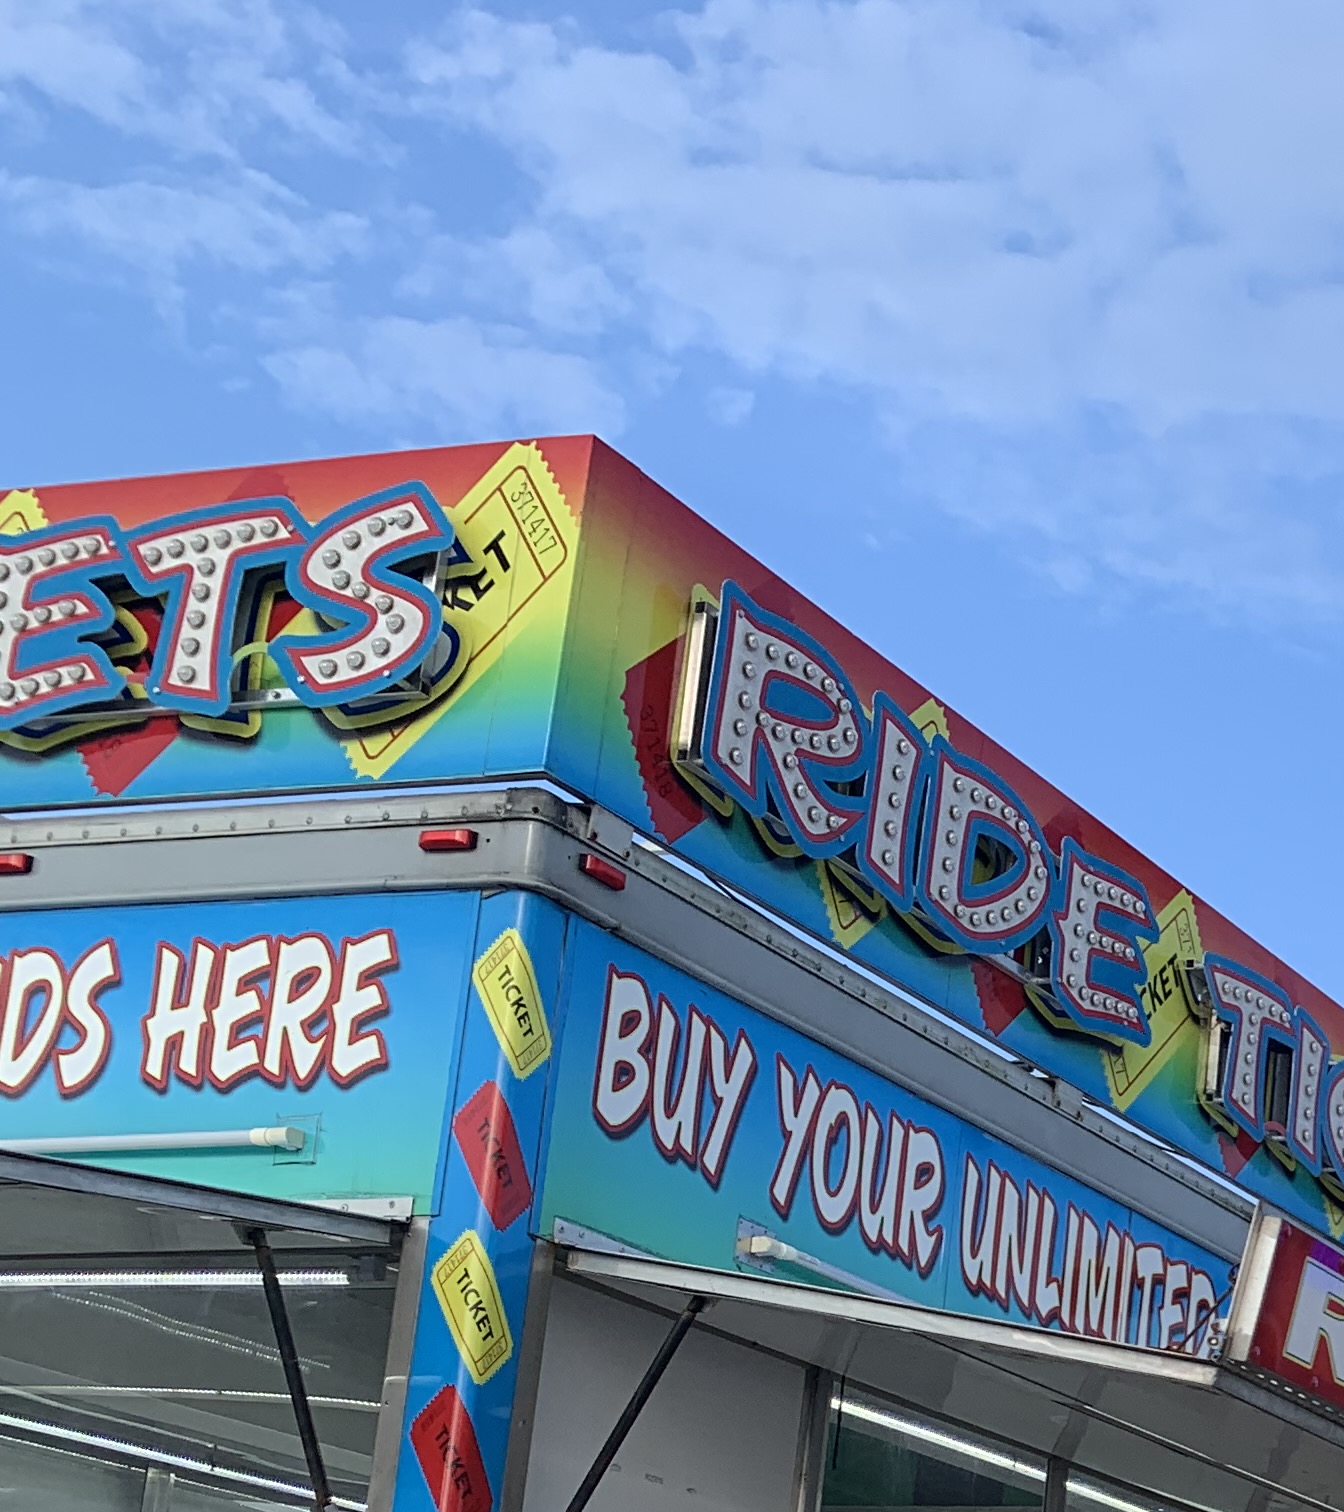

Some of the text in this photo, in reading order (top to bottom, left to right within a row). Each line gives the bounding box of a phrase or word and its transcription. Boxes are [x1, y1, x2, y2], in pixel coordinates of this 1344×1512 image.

[510, 481, 557, 556] 371417
[703, 583, 1156, 1043] RIDE
[0, 929, 398, 1097] DS HERE
[498, 964, 534, 1037] TICKET
[477, 1117, 512, 1188] TICKET
[593, 964, 1219, 1358] BUY YOUR UNLIMITED
[455, 1266, 494, 1344] TICKET
[434, 1422, 473, 1500] TICKET
